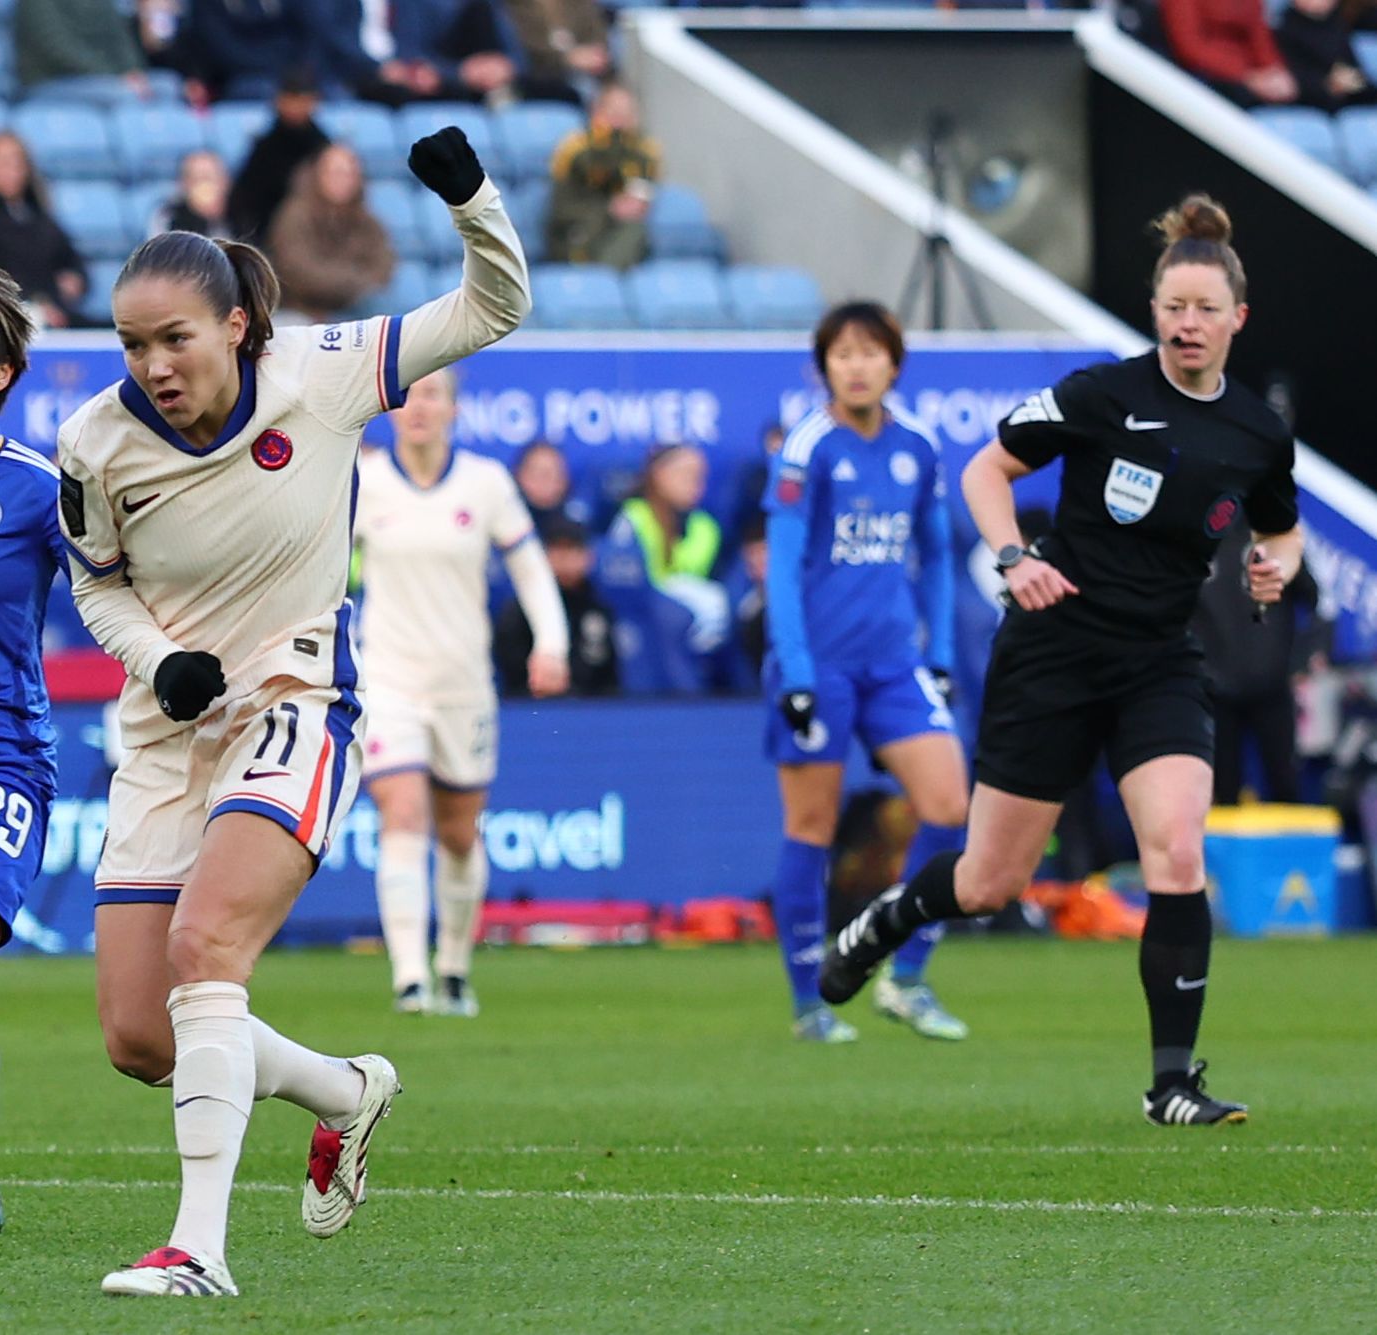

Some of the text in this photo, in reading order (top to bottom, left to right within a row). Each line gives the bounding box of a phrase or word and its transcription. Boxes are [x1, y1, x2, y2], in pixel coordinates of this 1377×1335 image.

[454, 389, 537, 445] NG
[544, 388, 720, 445] POWER
[1115, 464, 1154, 490] FIFA
[835, 512, 911, 544] KING
[253, 702, 299, 767] 11
[477, 792, 623, 872] avel
